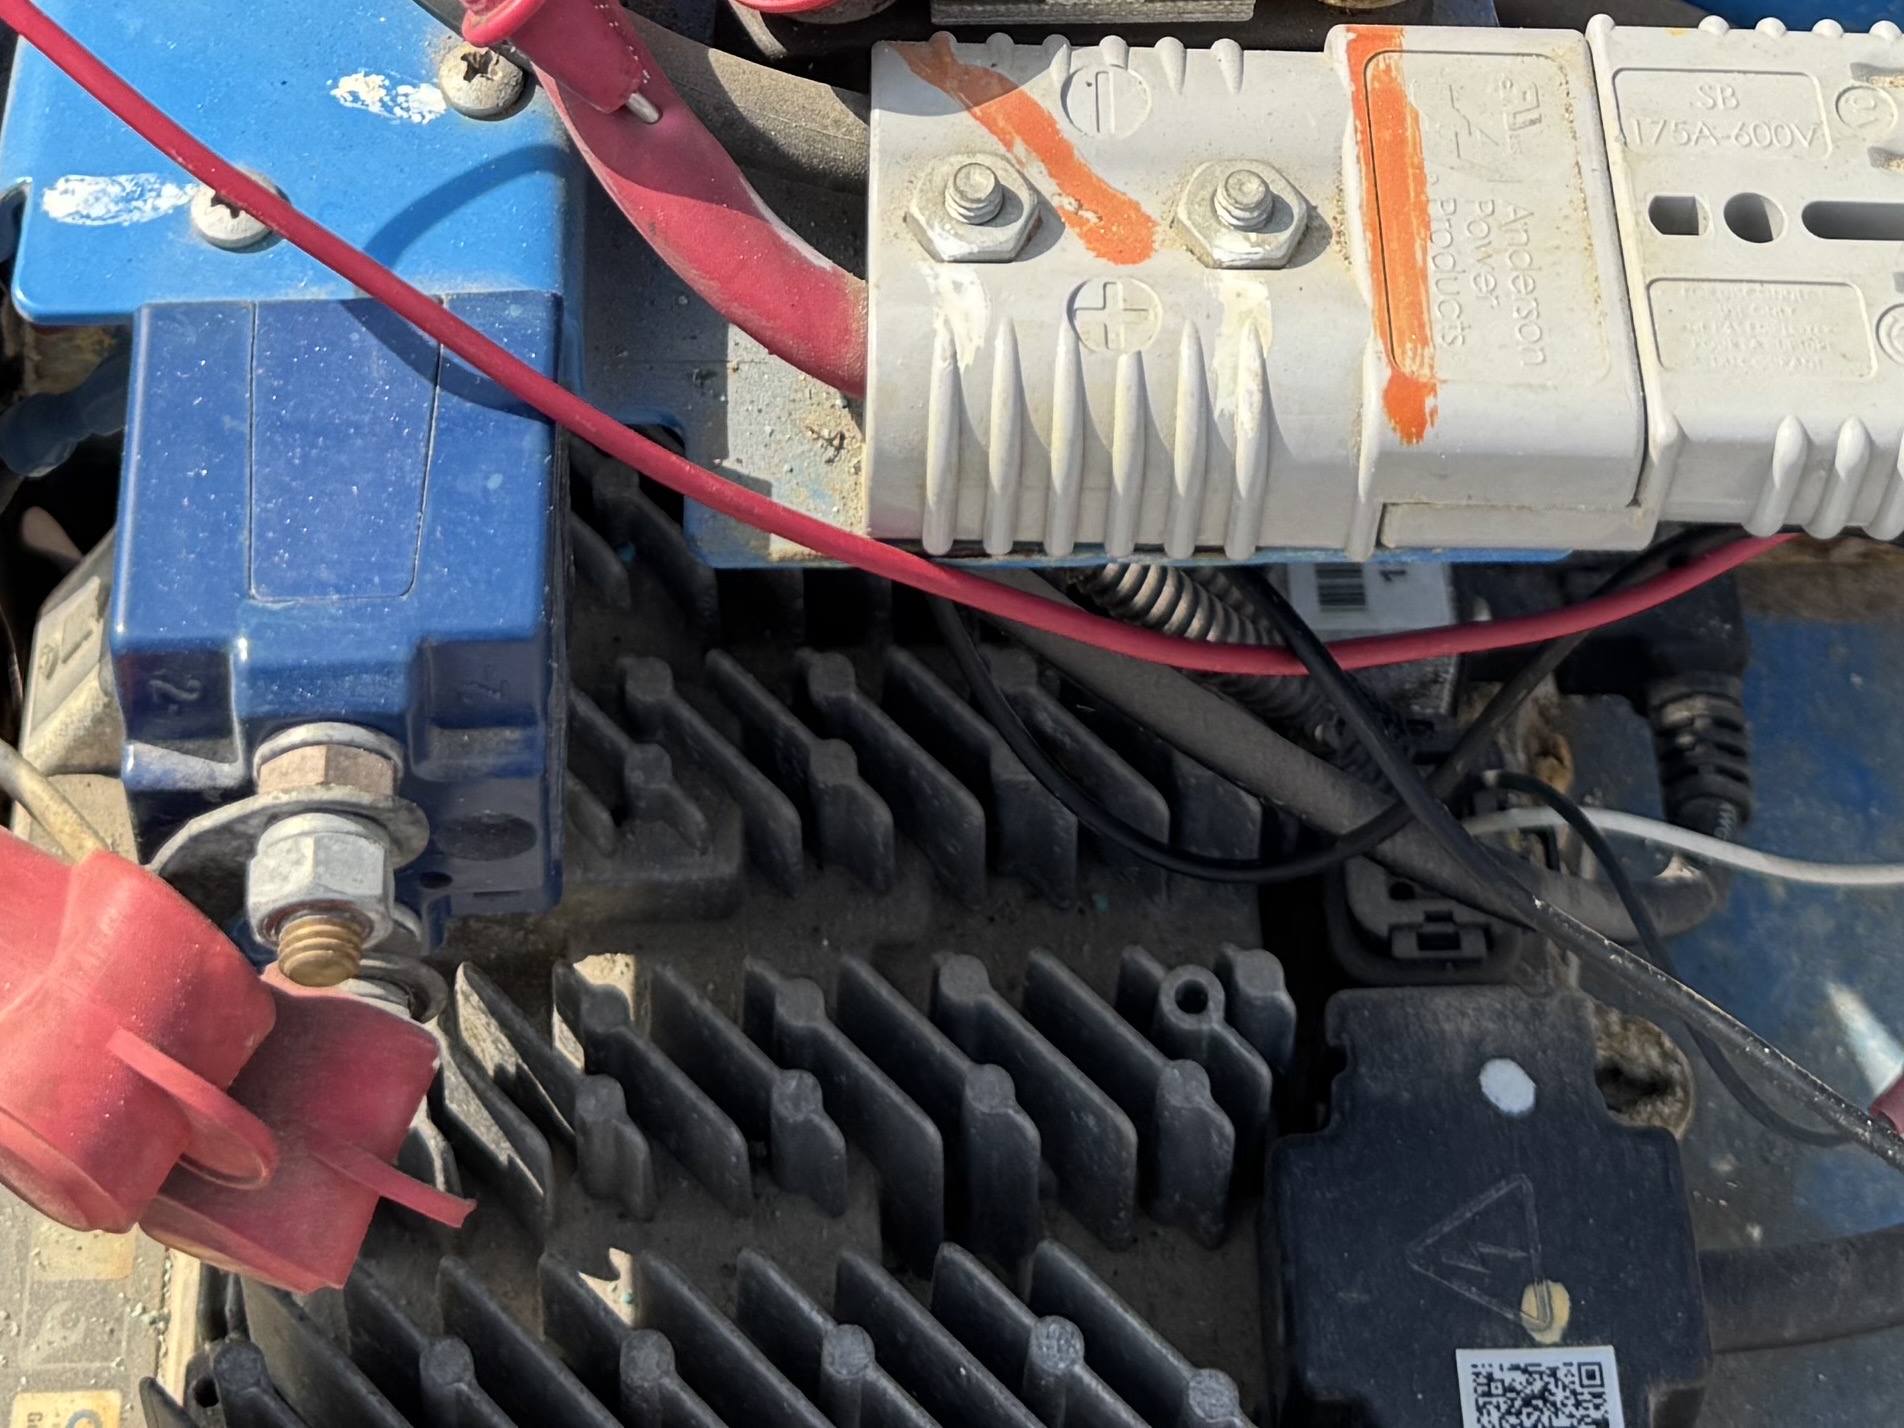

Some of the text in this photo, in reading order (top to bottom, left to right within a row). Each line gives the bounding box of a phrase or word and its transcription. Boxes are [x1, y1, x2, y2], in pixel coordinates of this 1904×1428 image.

[1630, 117, 1819, 148] 175A-600V
[1695, 83, 1741, 111] SB
[1429, 196, 1472, 348] Products
[1465, 197, 1501, 309] Power
[1498, 199, 1547, 368] Anderson
